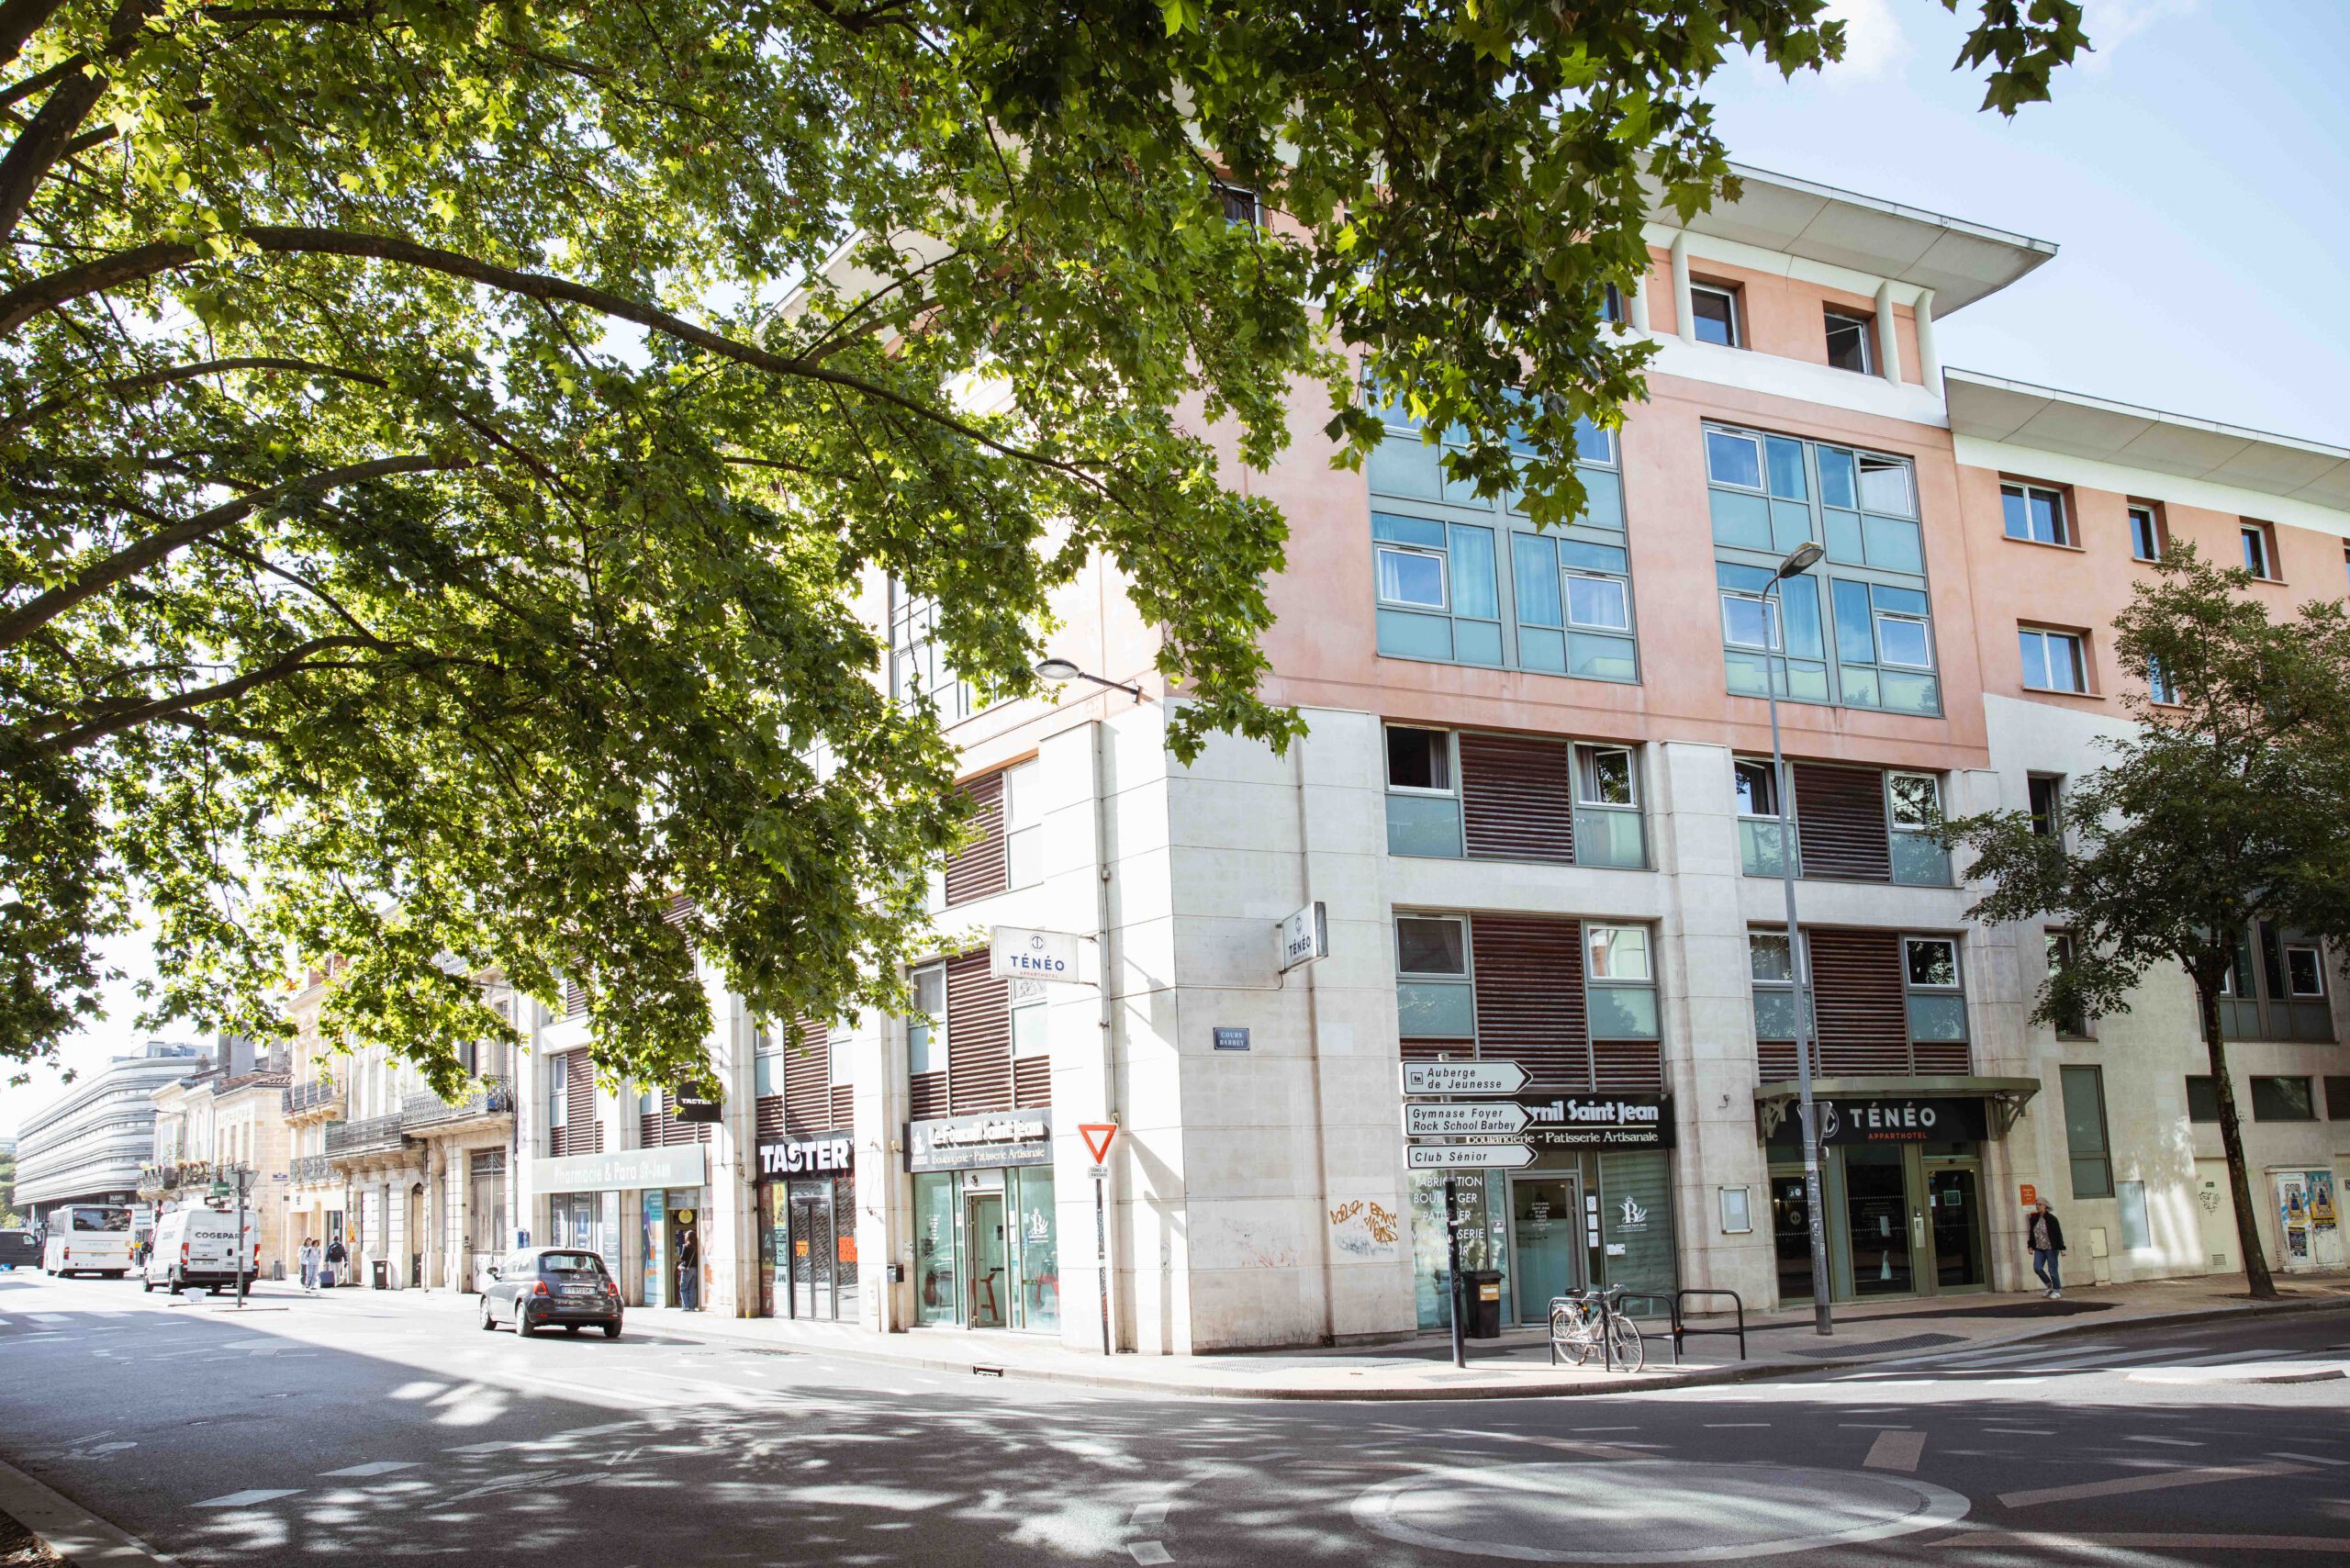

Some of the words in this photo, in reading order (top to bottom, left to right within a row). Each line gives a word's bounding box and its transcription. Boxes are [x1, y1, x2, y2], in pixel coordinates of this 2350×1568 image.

[1289, 935, 1311, 957] TÉNÉO
[1011, 953, 1064, 971] TÉNÉO
[1427, 1068, 1475, 1080] Auberge
[1428, 1080, 1440, 1089] de
[1449, 1080, 1502, 1089] Jeunesse
[1414, 1109, 1465, 1120] Gymnase
[1472, 1108, 1503, 1120] Foyer
[1567, 1099, 1616, 1121] Saint
[1617, 1102, 1659, 1125] Jean
[1850, 1102, 1936, 1127] TÉNÉO
[1414, 1121, 1438, 1130] Rock
[1444, 1121, 1477, 1130] School
[1481, 1121, 1516, 1131] Barbey
[1545, 1132, 1599, 1143] Patisserie
[1603, 1132, 1659, 1142] Artisanale
[1868, 1132, 1928, 1140] APPARTHOTEL
[760, 1138, 849, 1173] TASTER
[1416, 1152, 1442, 1161] Club
[1449, 1151, 1487, 1161] Sénior
[554, 1163, 602, 1184] Pharmacie
[604, 1162, 611, 1182] &
[614, 1161, 636, 1181] Para
[1415, 1176, 1483, 1187] FABRITION
